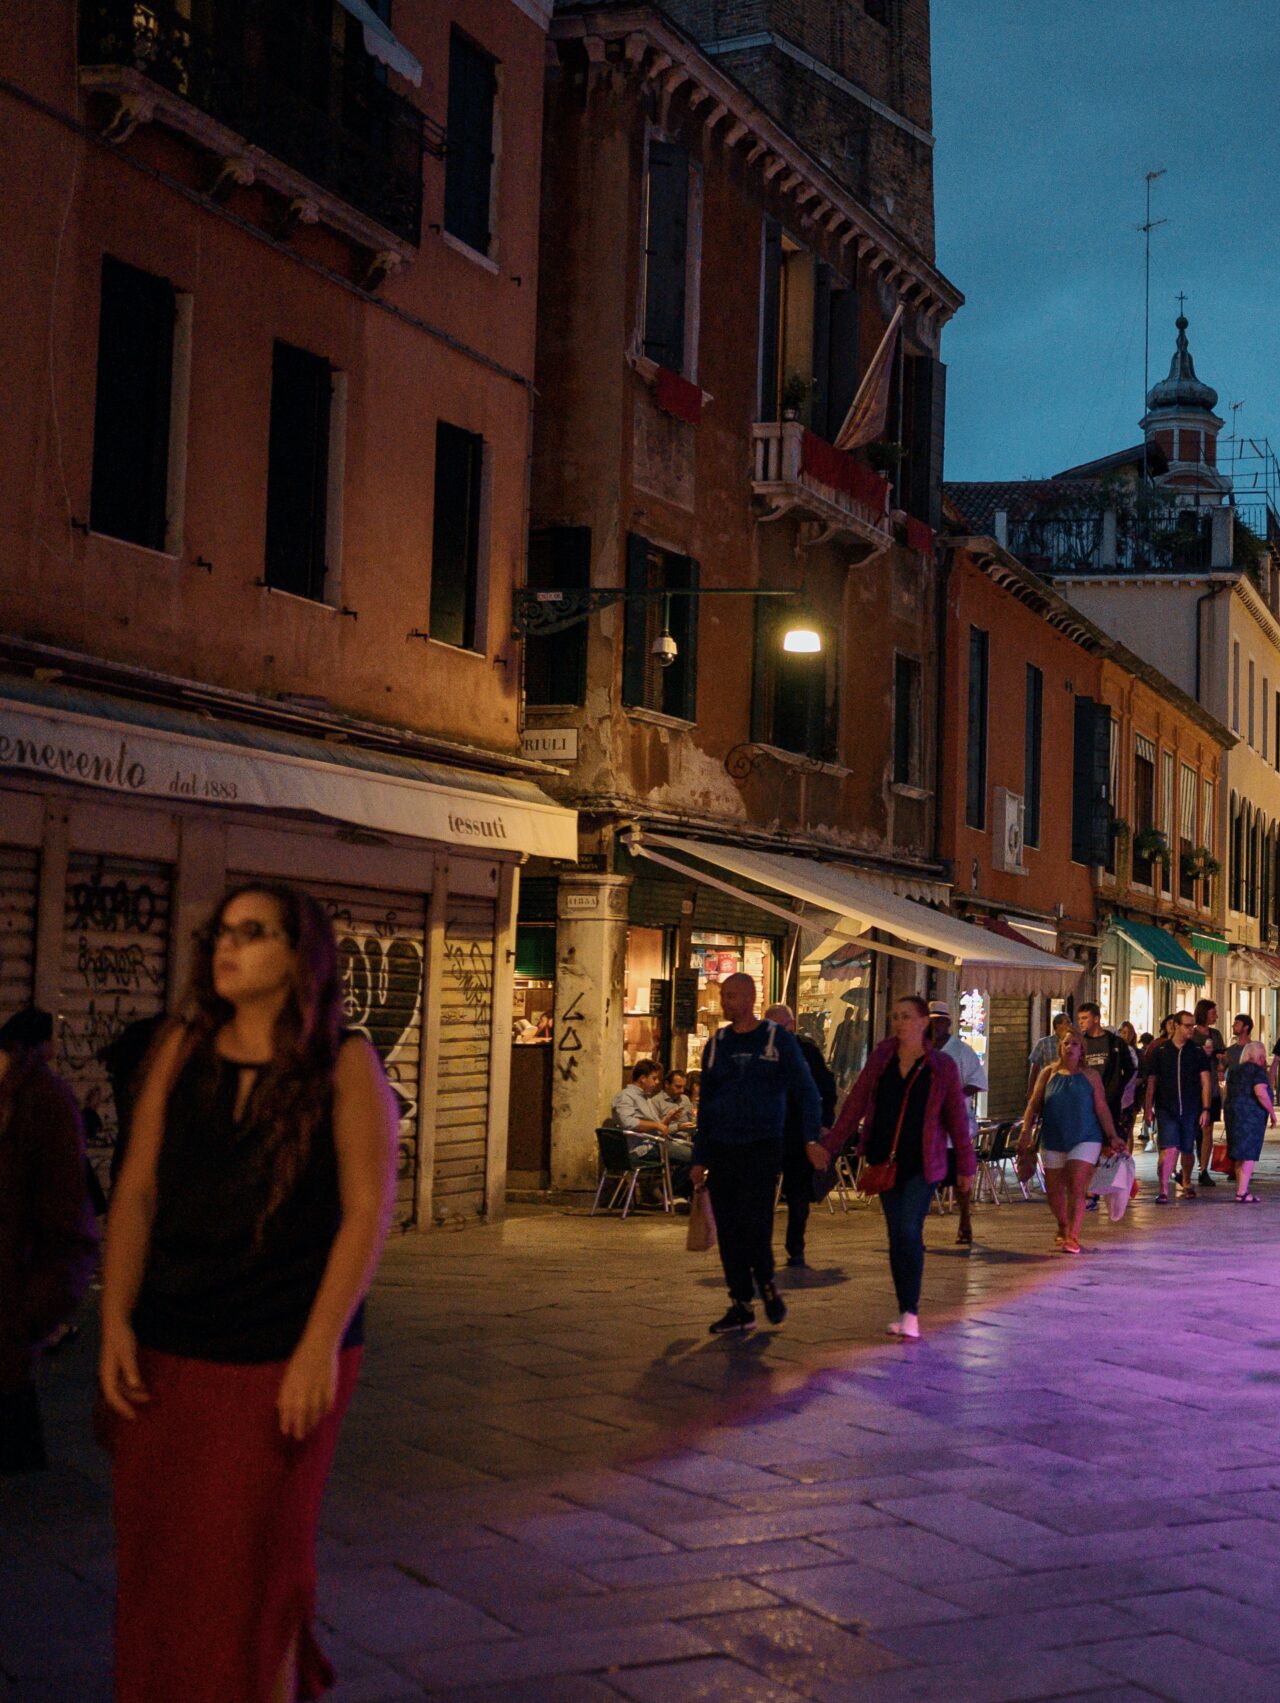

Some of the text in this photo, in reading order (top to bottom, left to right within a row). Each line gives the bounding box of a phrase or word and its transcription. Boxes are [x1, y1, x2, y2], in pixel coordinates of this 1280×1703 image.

[168, 771, 198, 796] dal
[202, 780, 239, 799] 1883
[447, 811, 508, 839] tessuti
